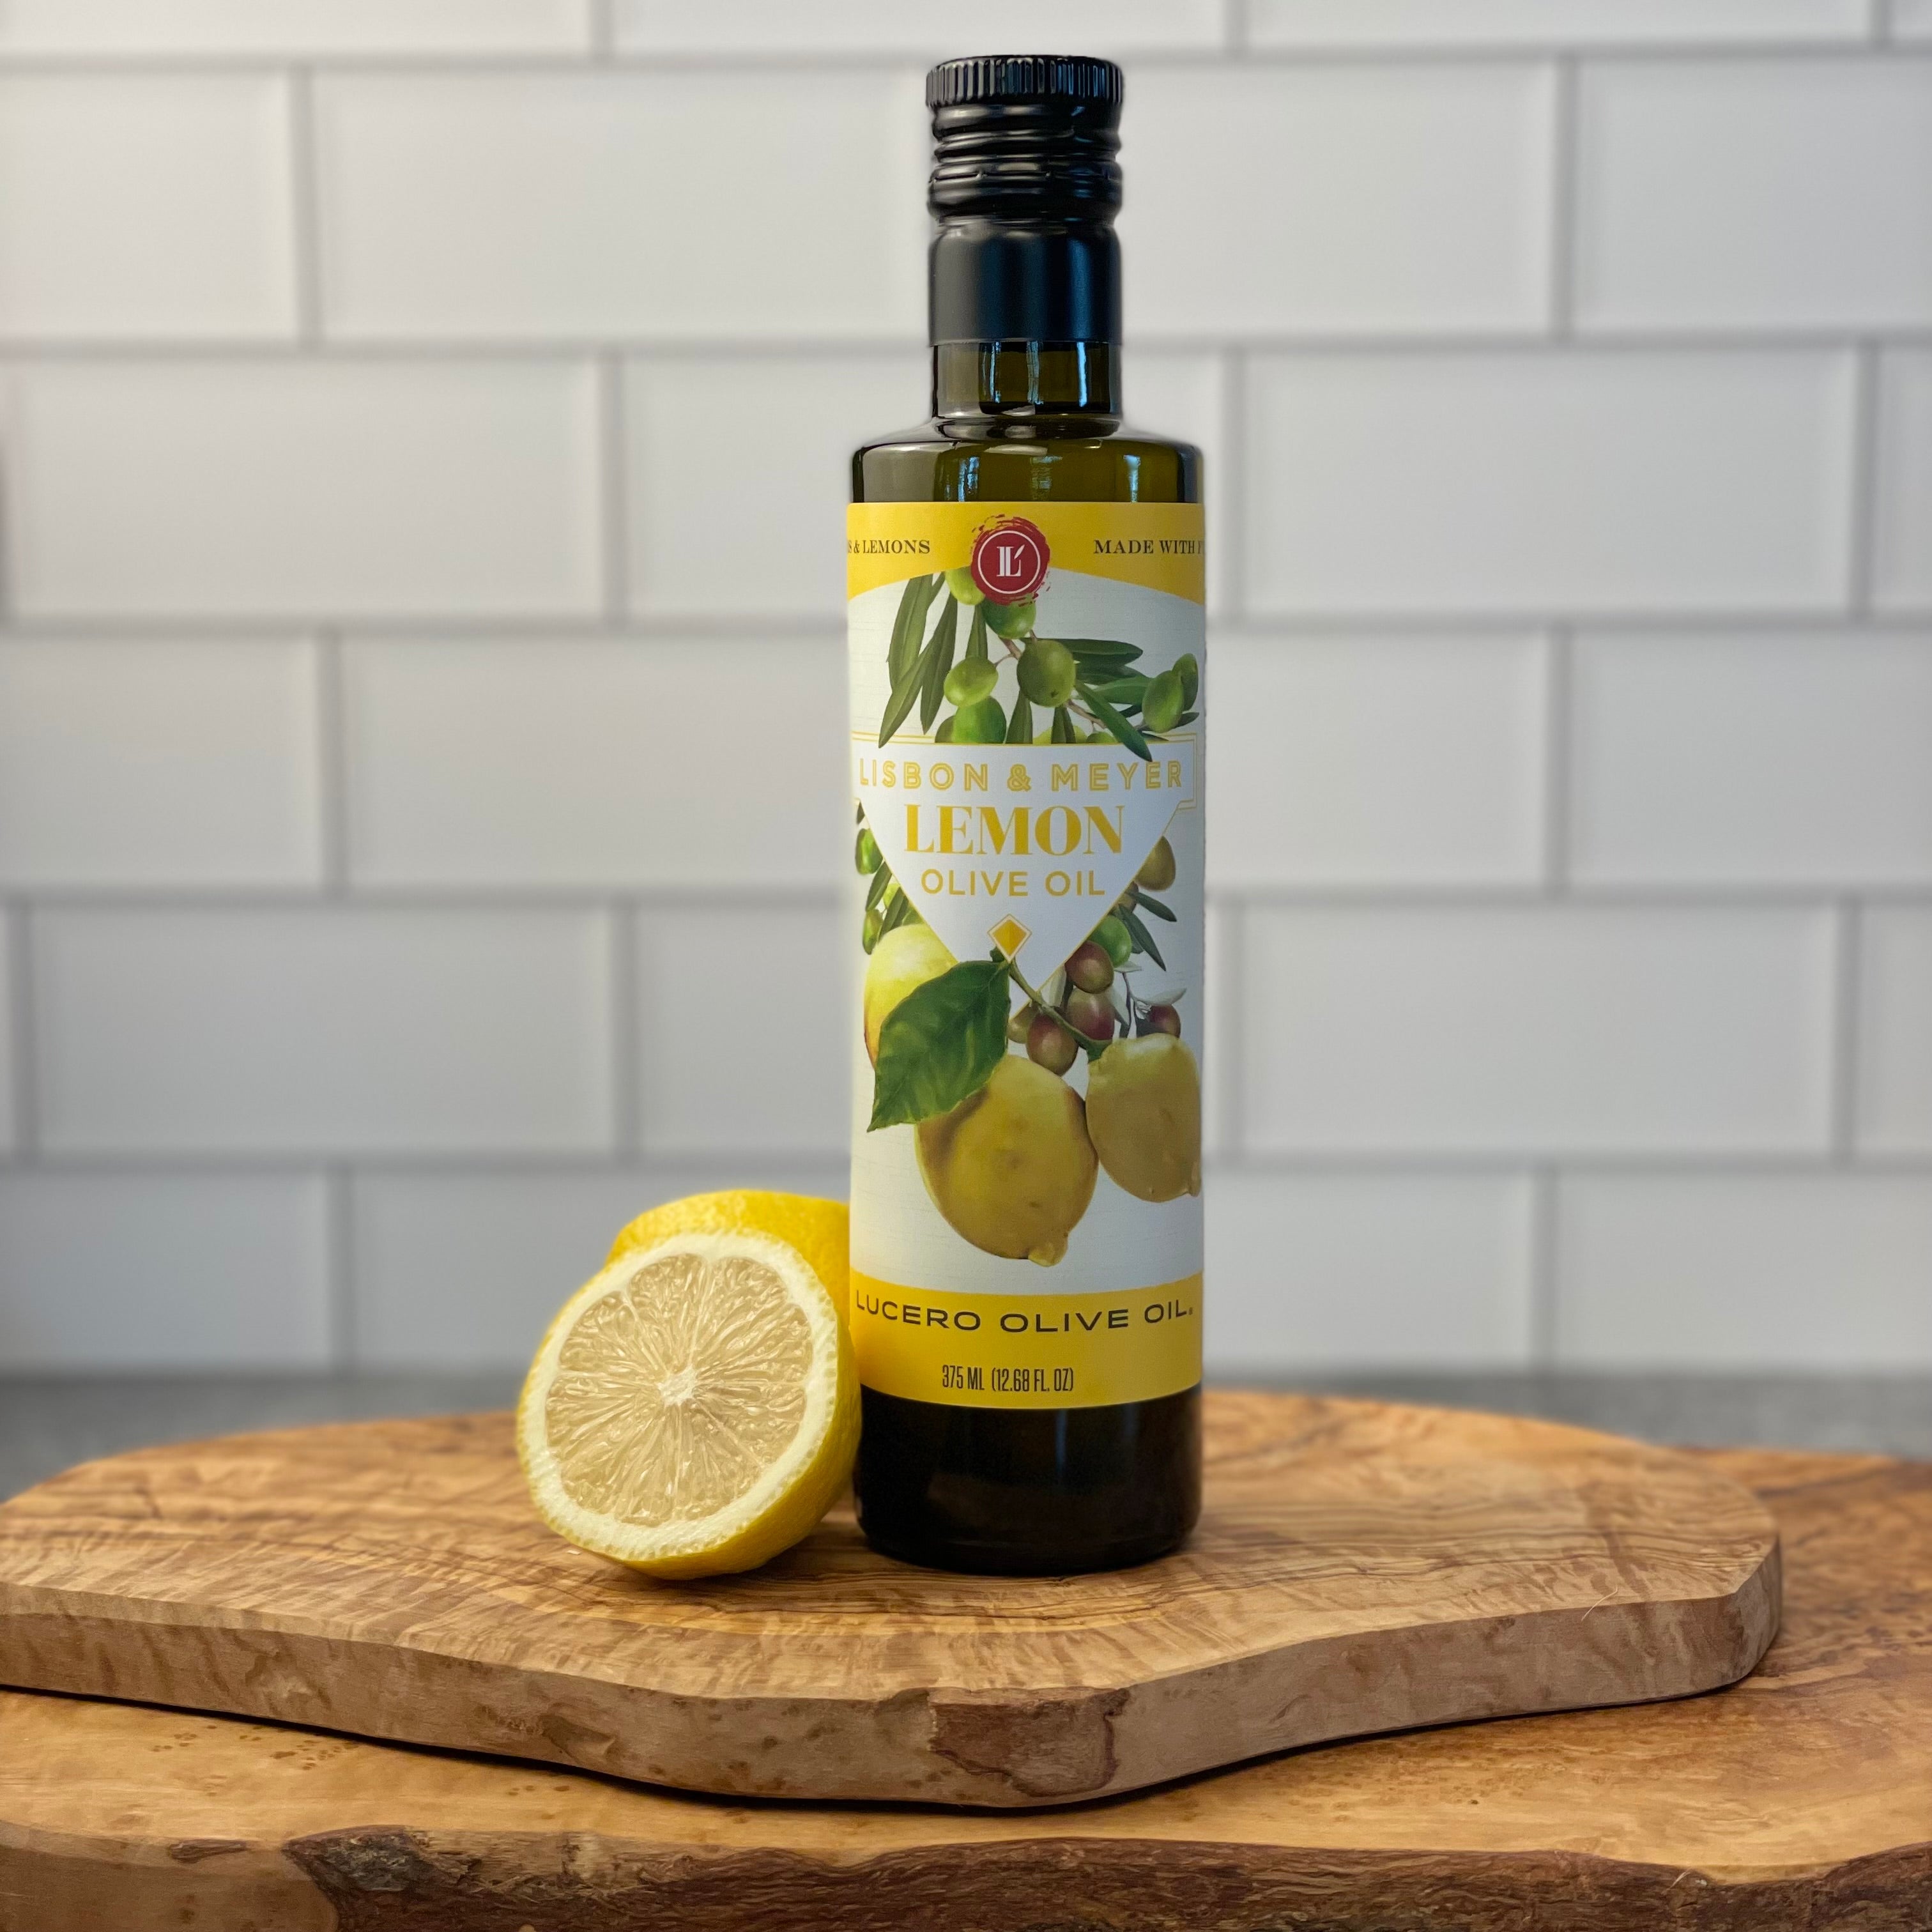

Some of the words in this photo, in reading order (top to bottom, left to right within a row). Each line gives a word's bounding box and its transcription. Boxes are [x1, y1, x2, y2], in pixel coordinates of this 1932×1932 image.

[854, 540, 860, 553] &
[862, 539, 930, 554] LEMONS
[1094, 540, 1154, 554] MADE
[1159, 540, 1195, 554] WITH
[859, 758, 988, 791] LISBON
[1007, 764, 1031, 792] &
[1052, 760, 1182, 791] MEYER
[904, 804, 1124, 856] LEMON
[921, 869, 1028, 896] OLIVE
[1045, 870, 1105, 896] OIL
[856, 1289, 981, 1331] LUCERO
[1000, 1309, 1129, 1332] OLIVE
[942, 1364, 963, 1389] 375
[967, 1367, 985, 1391] ML
[991, 1367, 1030, 1392] (12.68
[1034, 1368, 1050, 1392] FL.
[1054, 1367, 1074, 1392] OZ)
